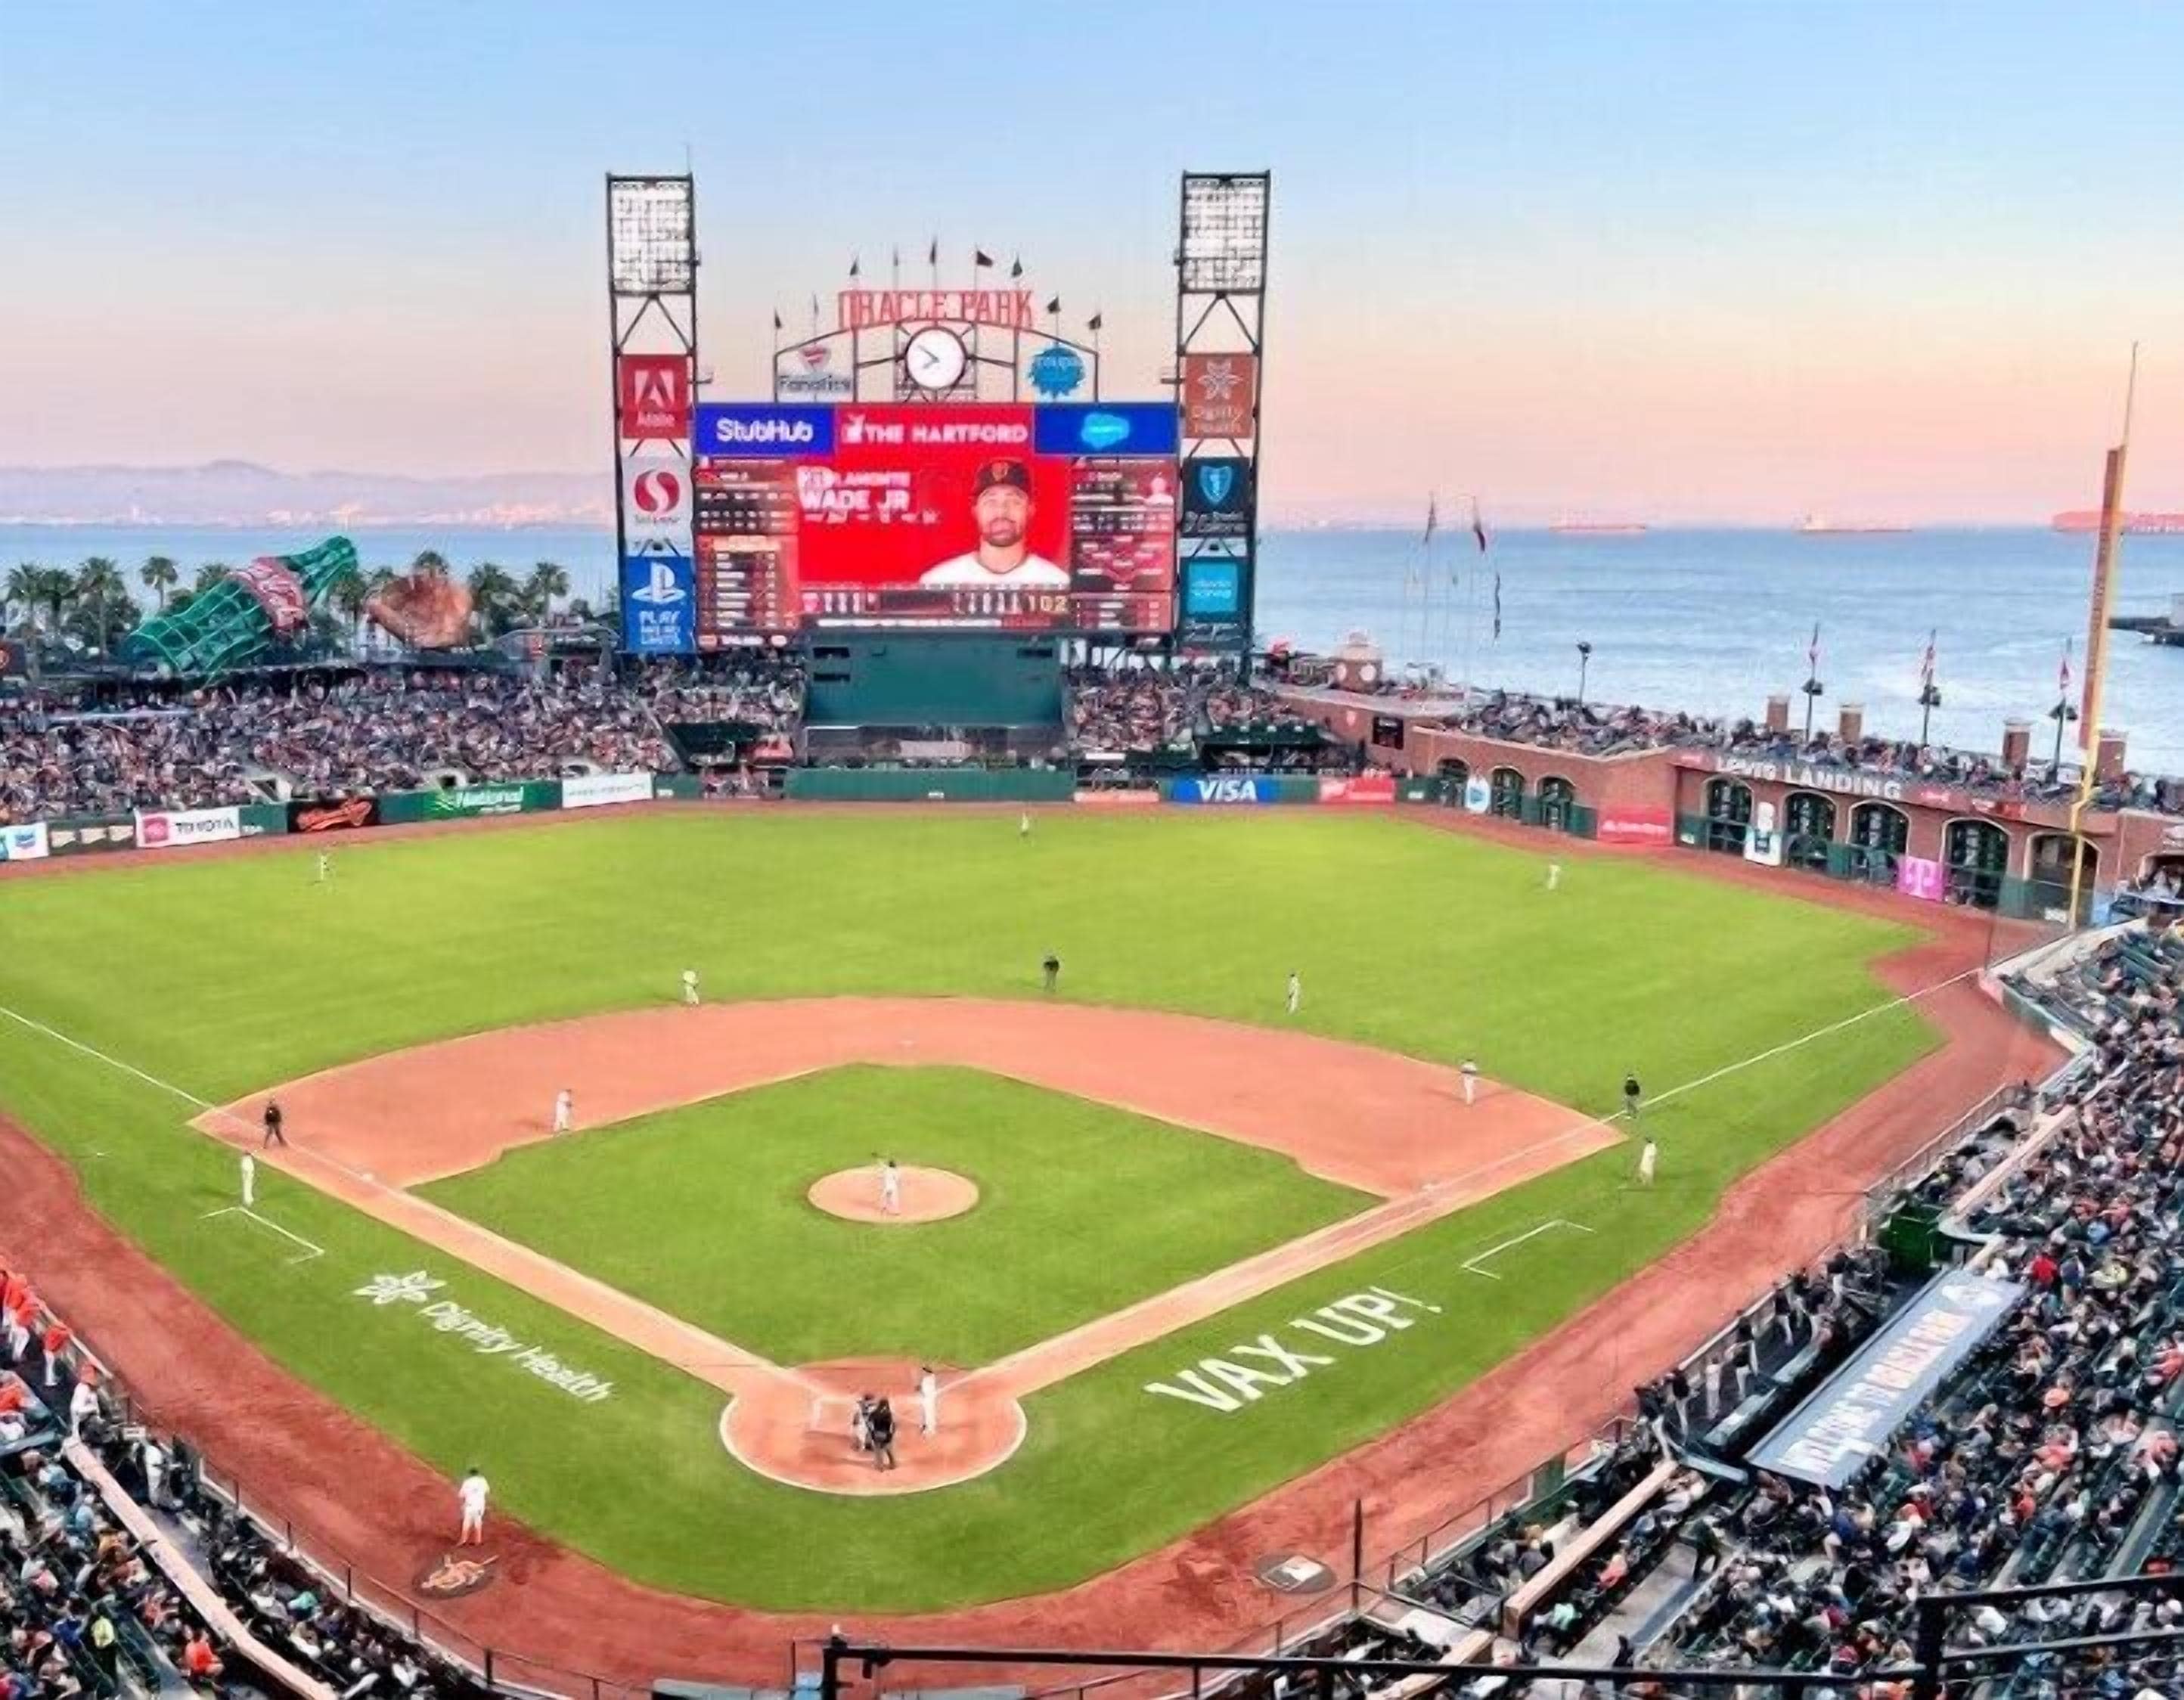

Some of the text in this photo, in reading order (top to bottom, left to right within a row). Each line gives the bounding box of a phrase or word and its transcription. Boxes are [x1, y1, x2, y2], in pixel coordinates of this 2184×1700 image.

[839, 290, 1032, 327] ORACLE PARK
[716, 418, 813, 442] StubHub
[867, 424, 1028, 443] THE HARTFORD
[799, 489, 869, 510] WADE
[877, 489, 911, 510] JR
[639, 610, 681, 625] PLAY
[1195, 780, 1258, 802] VISA
[1784, 765, 1902, 800] LANDING
[175, 817, 234, 834] TOYOTA
[1143, 1286, 1443, 1413] VAX UP!
